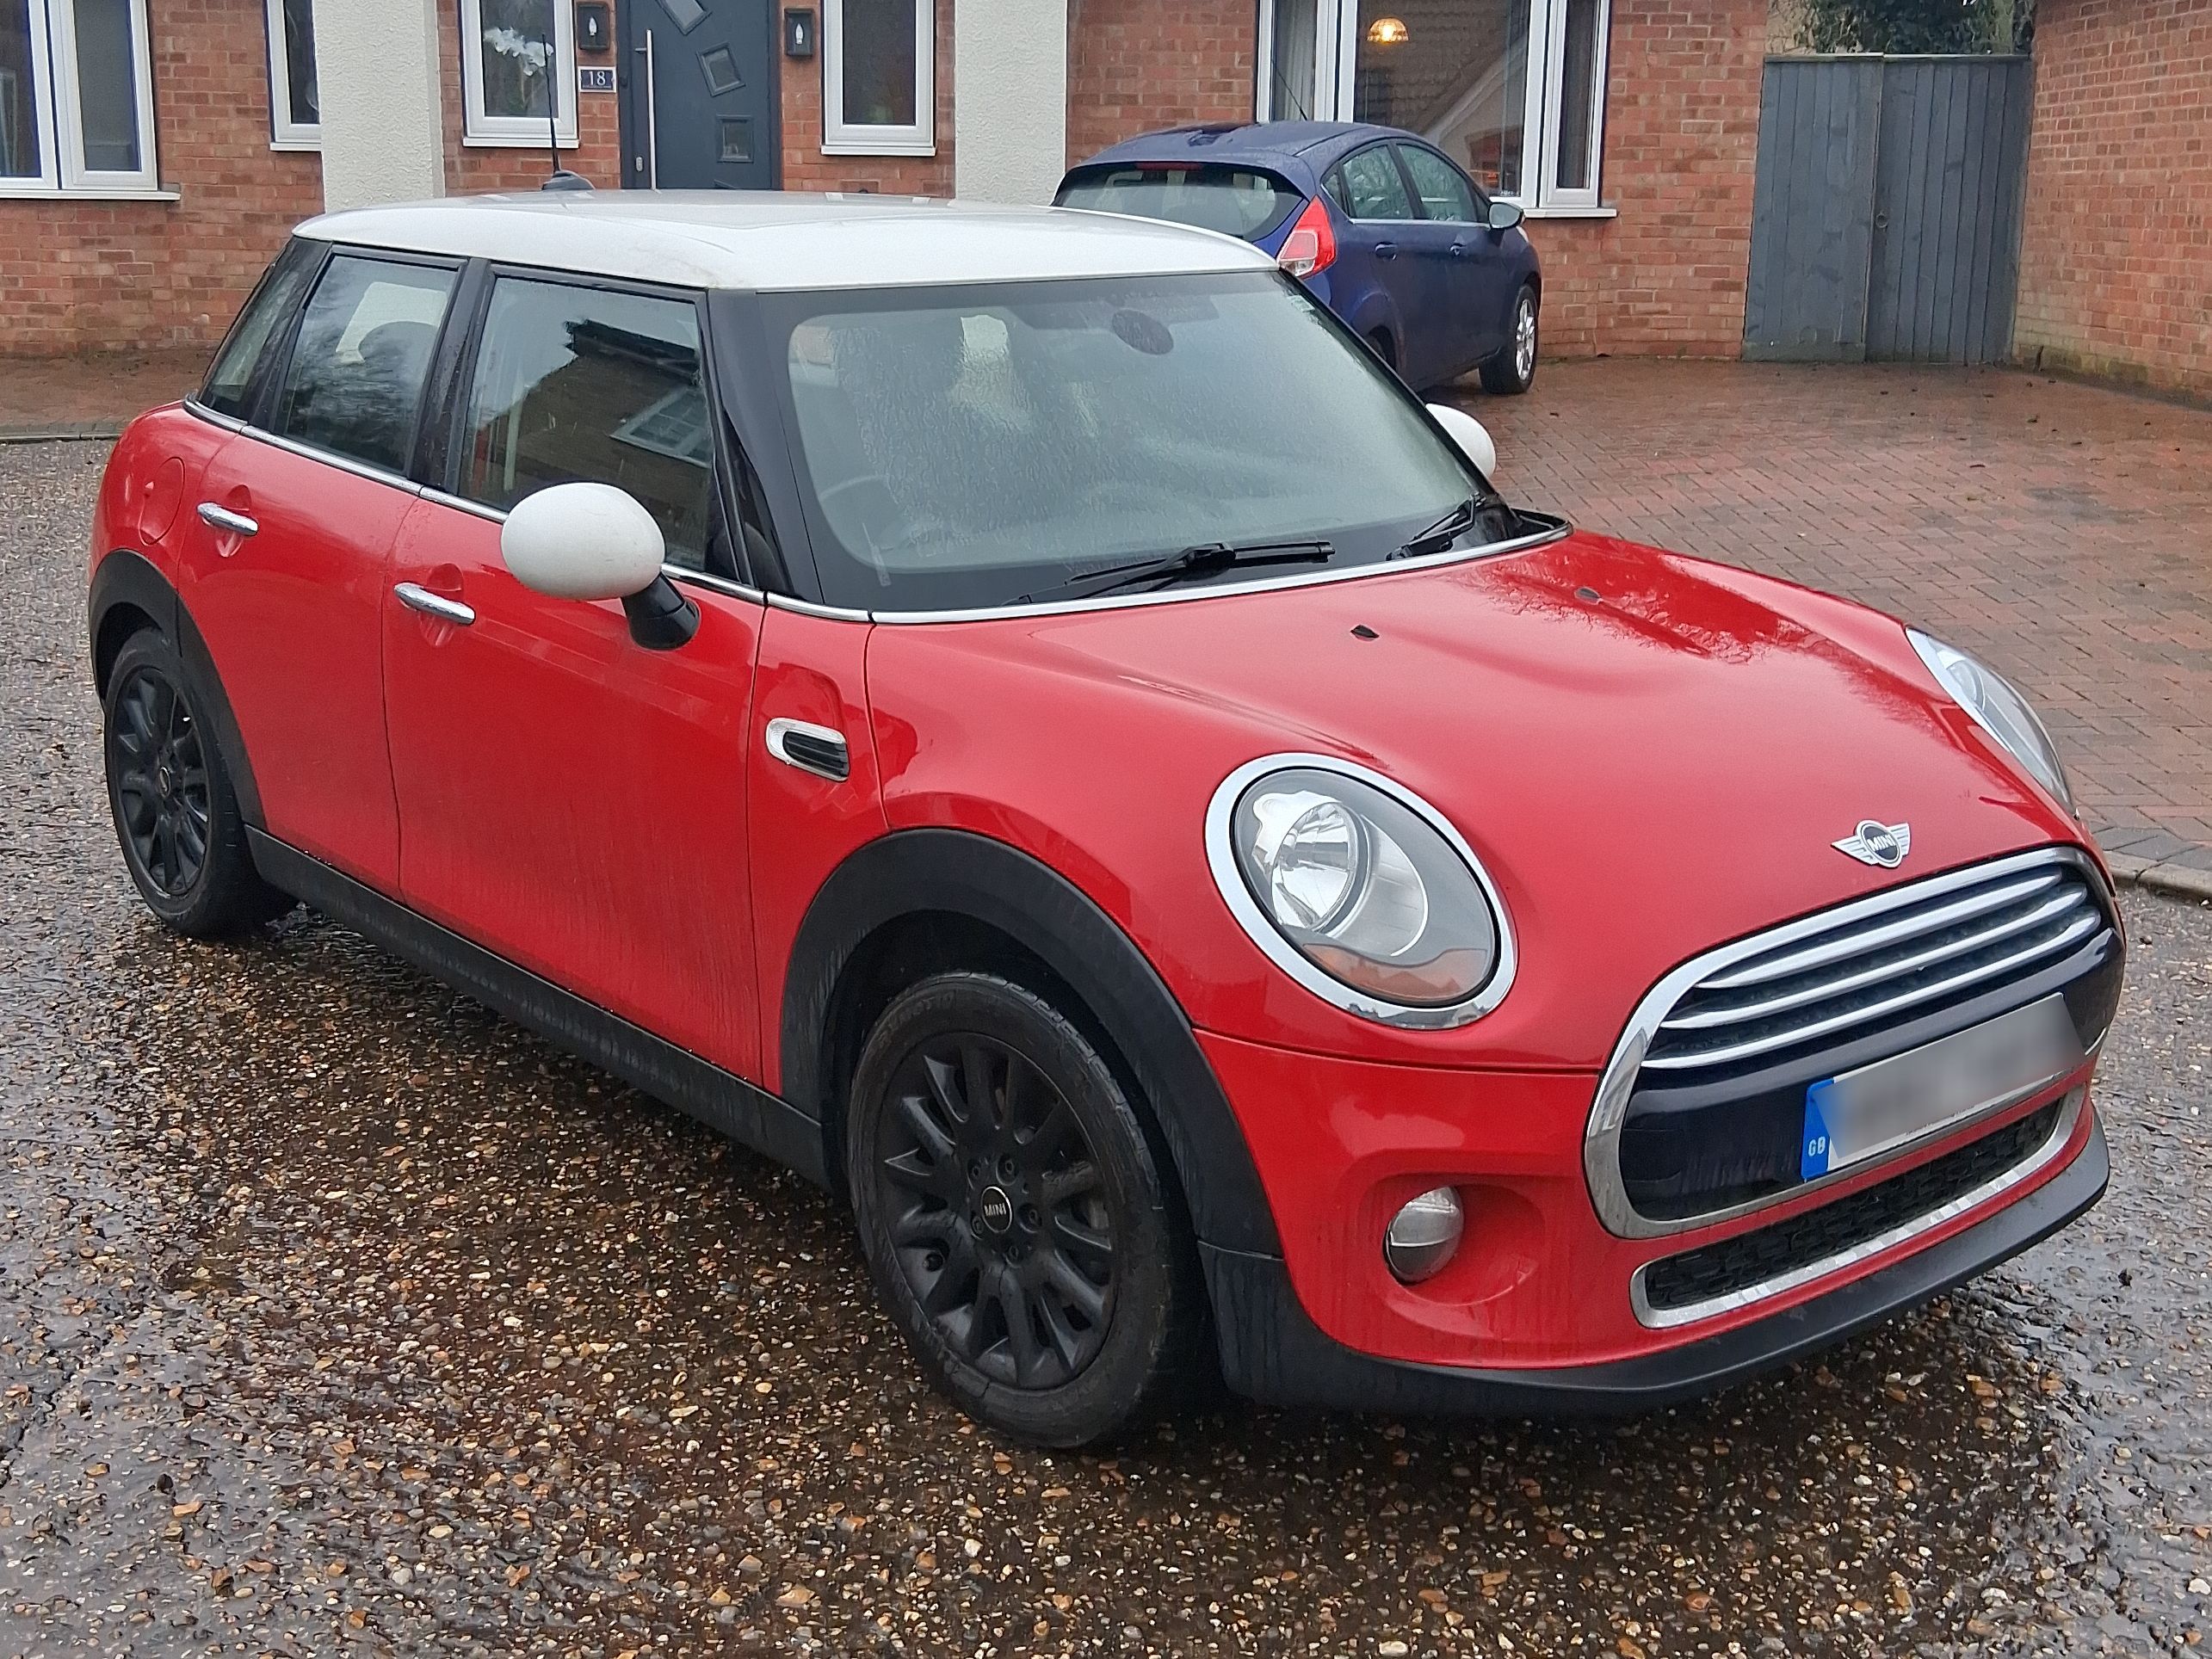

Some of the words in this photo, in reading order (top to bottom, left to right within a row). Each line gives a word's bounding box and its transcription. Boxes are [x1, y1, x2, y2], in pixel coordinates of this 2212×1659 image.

[589, 71, 606, 86] 18
[1866, 834, 1896, 852] MINI
[1807, 1136, 1826, 1157] GB
[984, 1202, 1007, 1217] MINI
